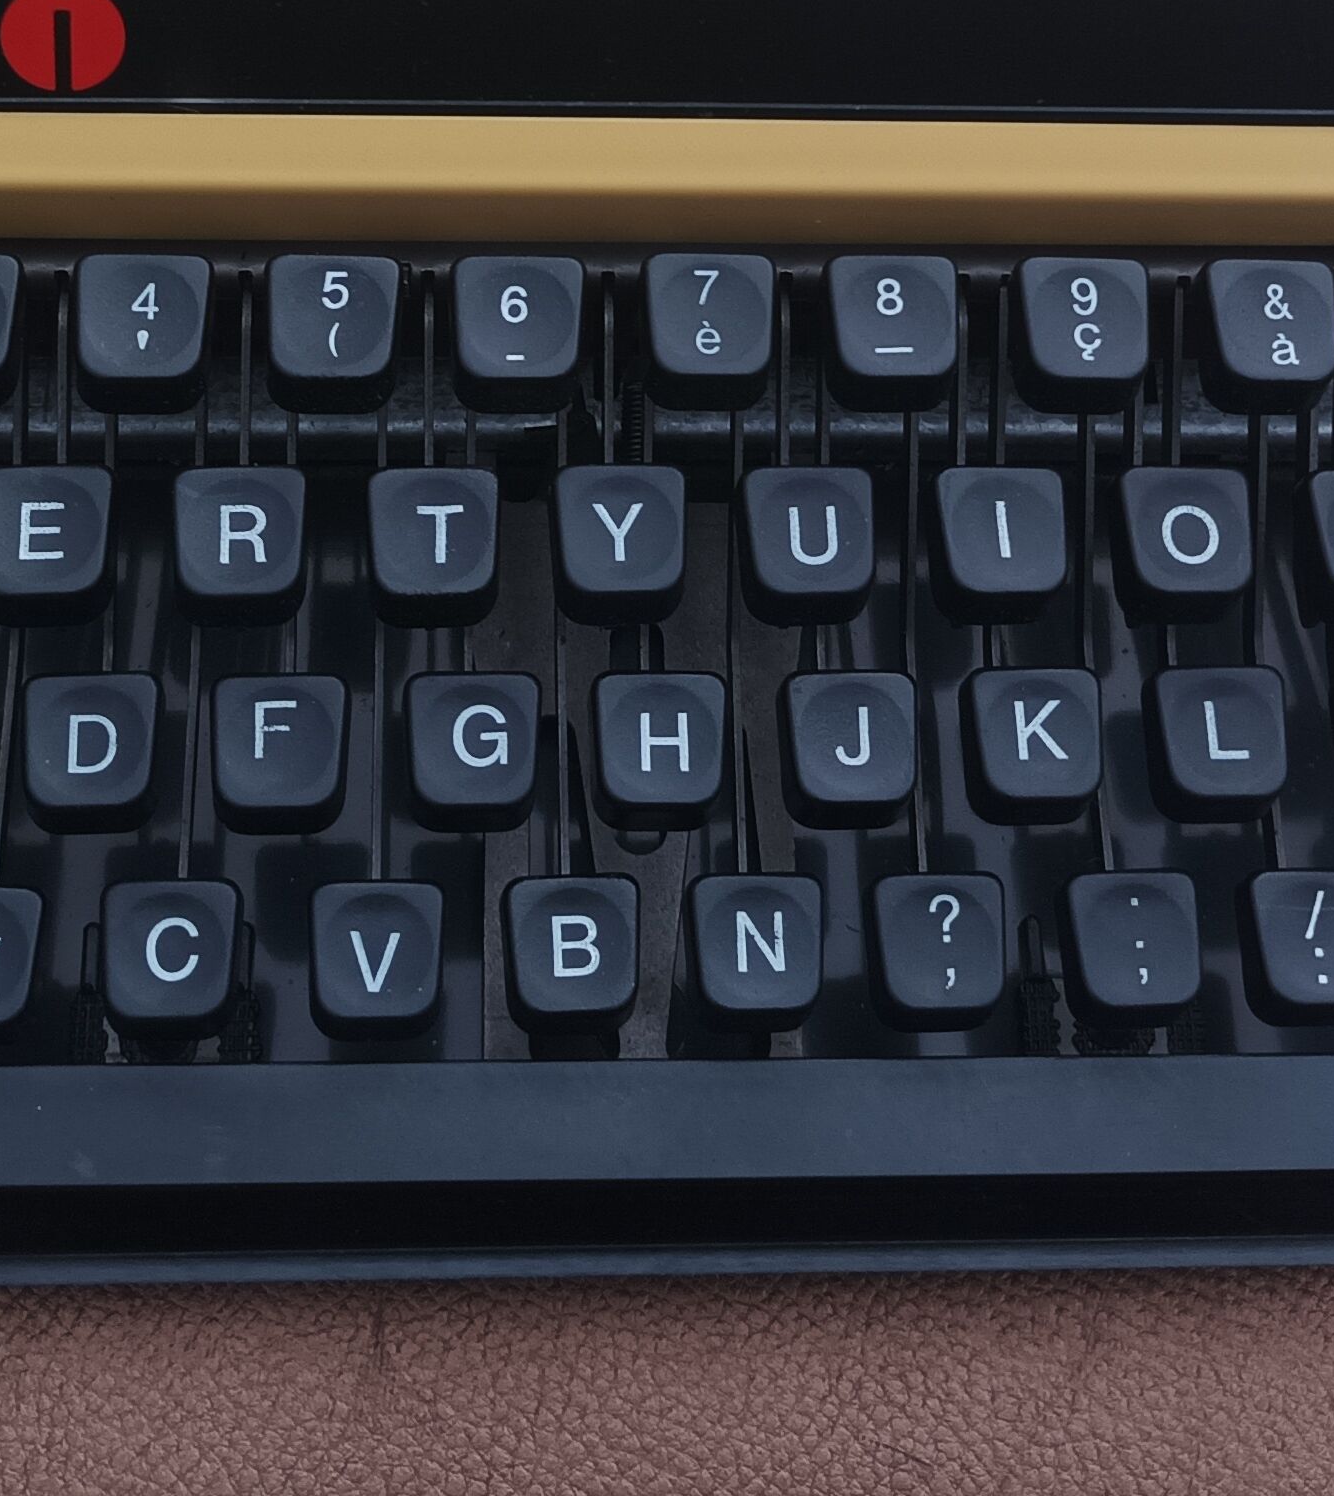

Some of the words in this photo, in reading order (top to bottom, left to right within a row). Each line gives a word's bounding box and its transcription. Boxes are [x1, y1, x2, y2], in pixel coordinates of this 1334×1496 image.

[131, 282, 160, 320] 4
[321, 271, 349, 310] 5
[500, 285, 528, 324] 6
[693, 270, 719, 306] 7
[876, 278, 904, 316] 8
[1070, 277, 1098, 316] 9
[1263, 283, 1294, 320] &
[328, 322, 340, 358] (
[695, 320, 722, 355] è
[1073, 322, 1102, 361] ç
[1271, 333, 1300, 365] à
[18, 501, 65, 561] E
[219, 504, 267, 565] R
[416, 504, 464, 564] T
[592, 502, 644, 562] Y
[788, 505, 838, 566] U
[995, 500, 1012, 559] I
[1161, 505, 1220, 565] O
[67, 714, 117, 774] D
[254, 700, 297, 759] F
[452, 704, 508, 768] G
[640, 712, 690, 772] H
[835, 706, 871, 766] J
[1013, 699, 1069, 761] K
[1203, 700, 1250, 760] L
[551, 915, 601, 978] B
[736, 910, 786, 973] N
[929, 894, 960, 943] ?
[145, 917, 199, 982] C
[349, 930, 401, 993] V
